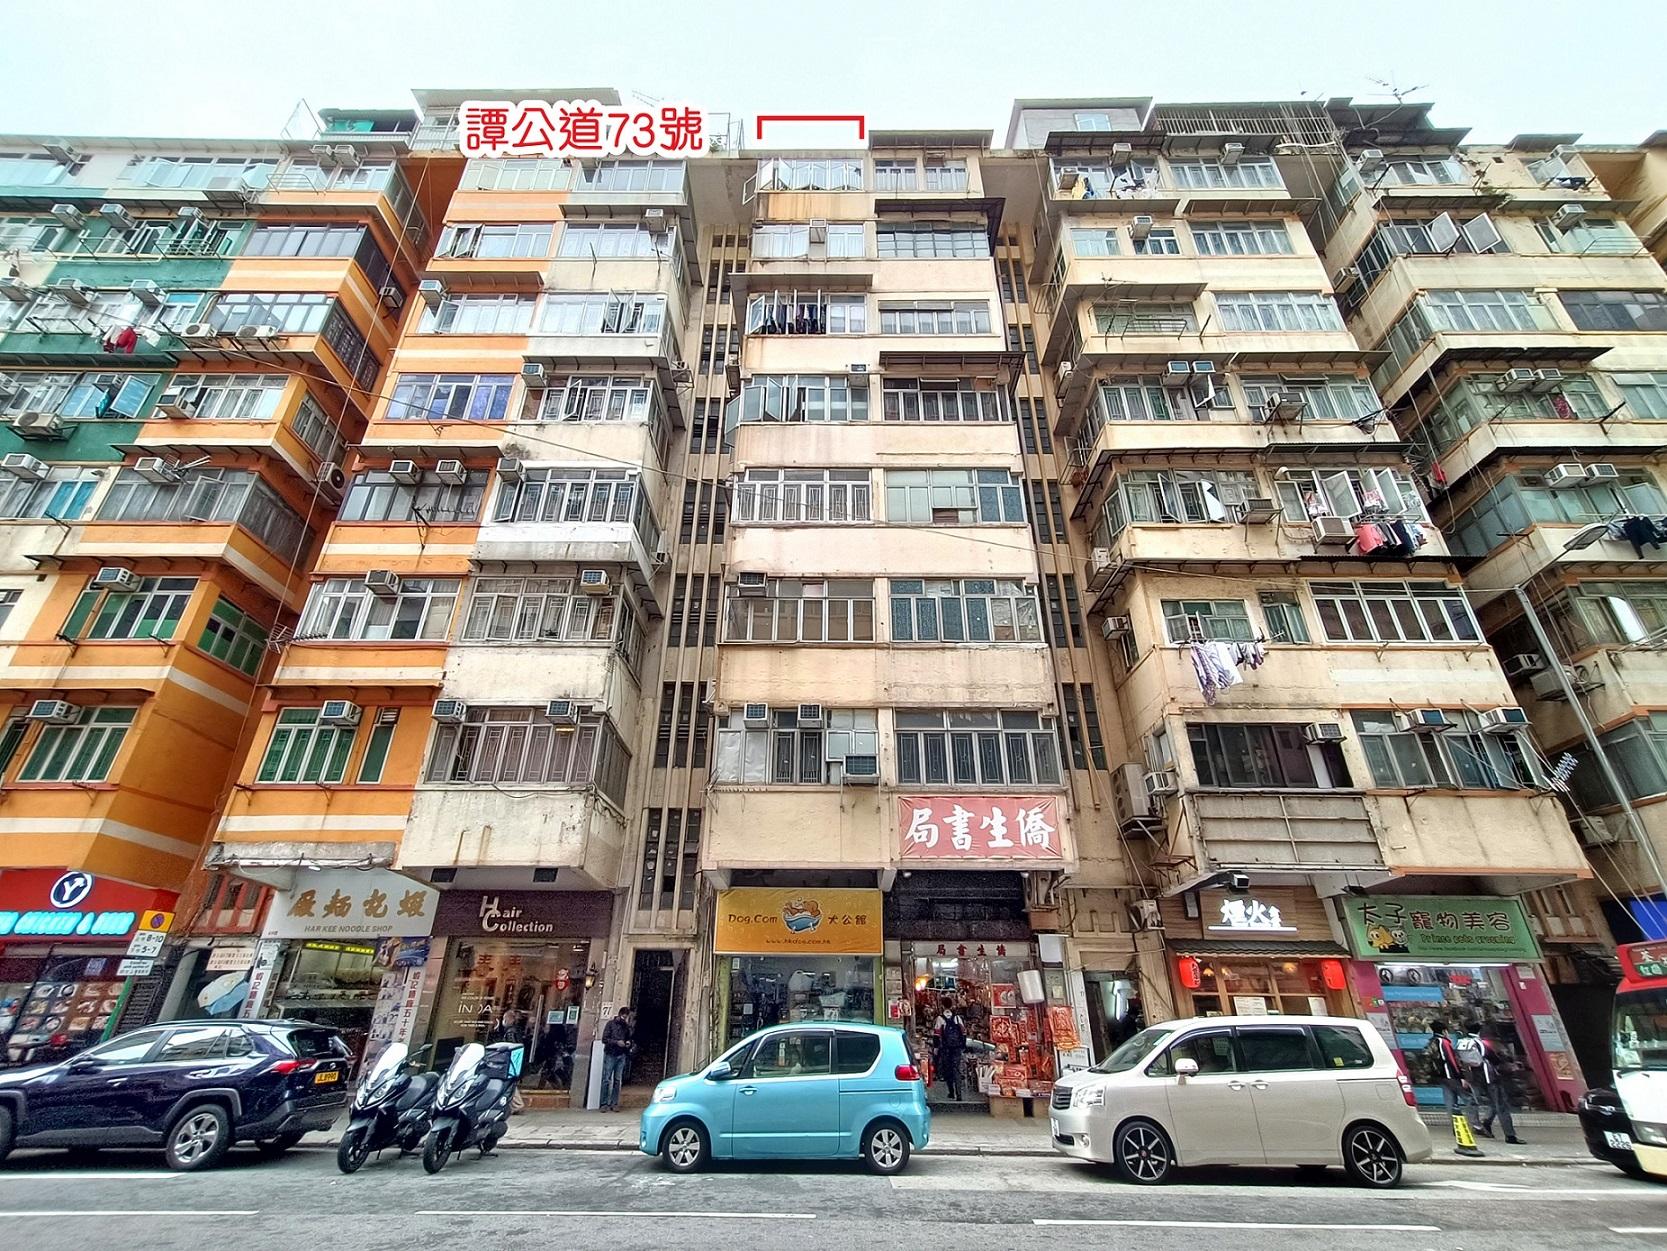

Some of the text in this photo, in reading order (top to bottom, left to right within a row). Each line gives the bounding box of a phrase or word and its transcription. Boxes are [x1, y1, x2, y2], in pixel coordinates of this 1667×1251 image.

[479, 895, 522, 918] Hair
[482, 909, 554, 932] Collection
[728, 914, 778, 925] Dog.Com
[304, 925, 393, 933] HAR KEE NOODLE SHOP
